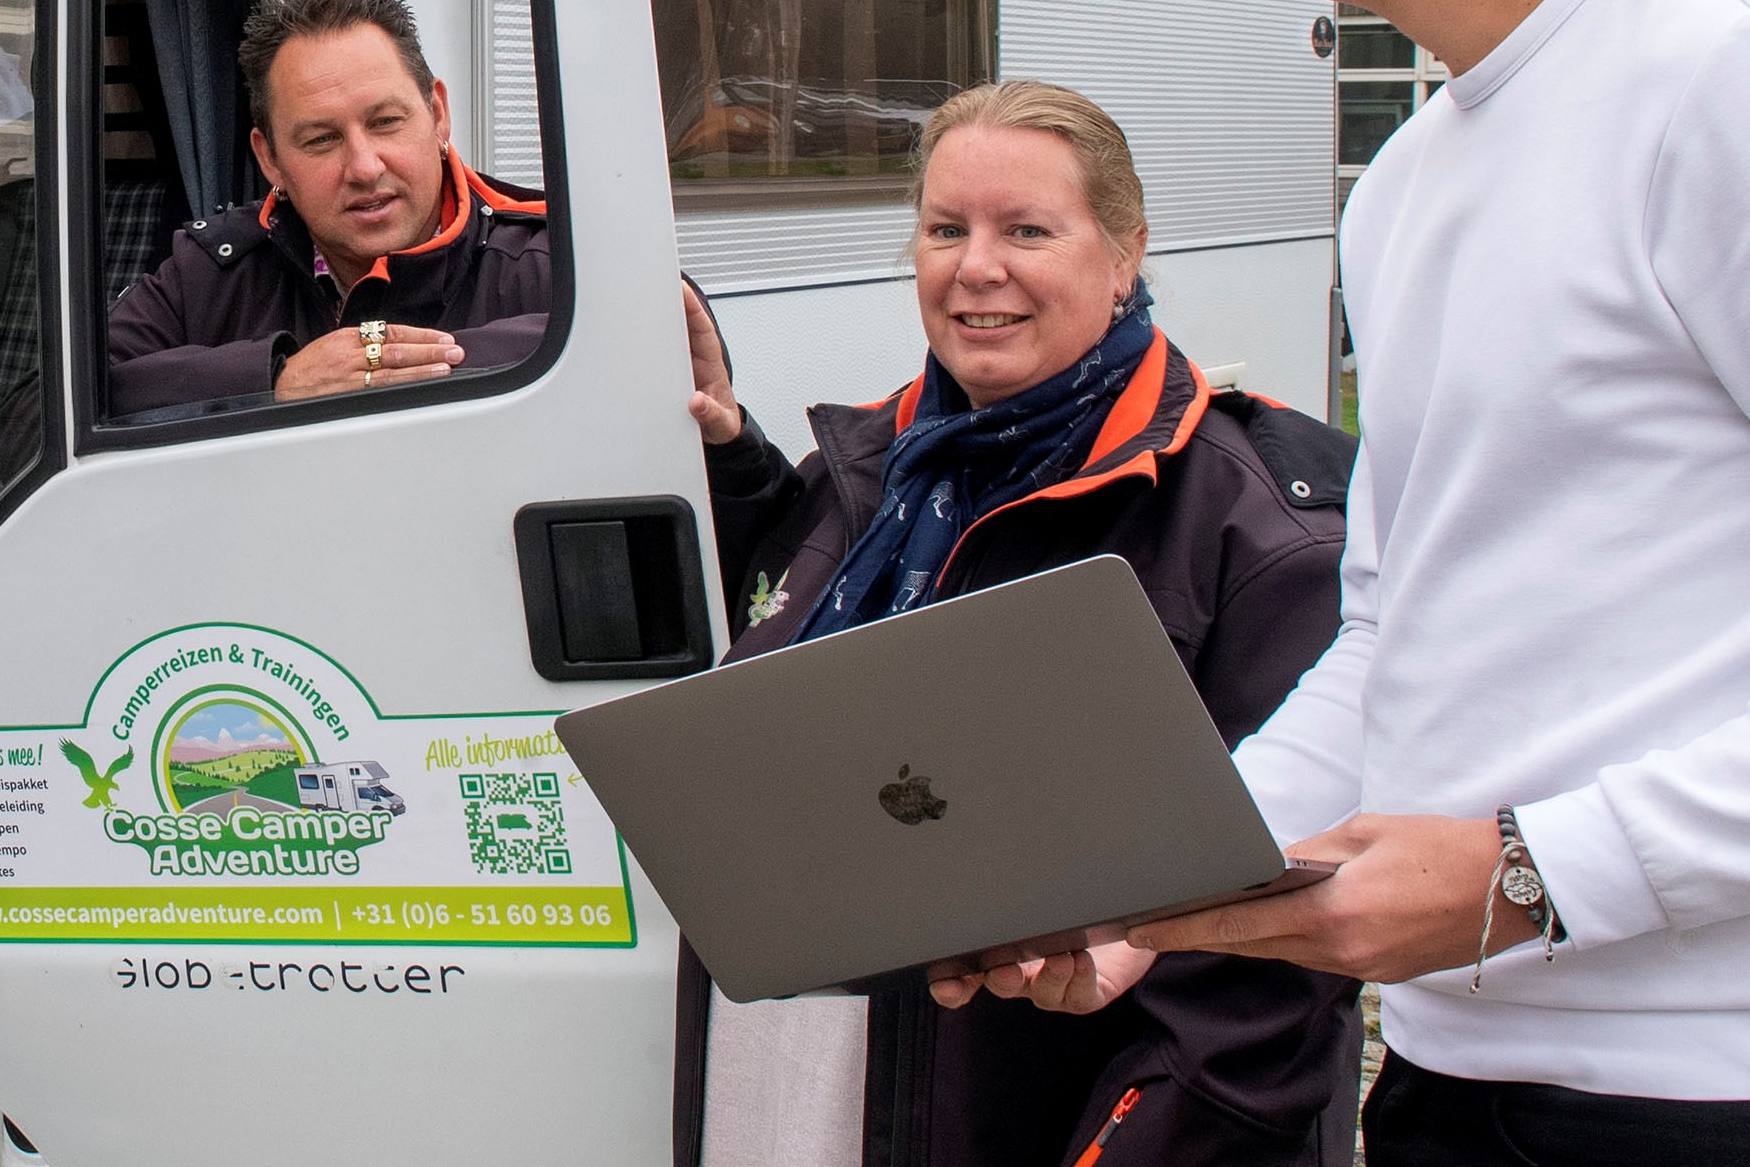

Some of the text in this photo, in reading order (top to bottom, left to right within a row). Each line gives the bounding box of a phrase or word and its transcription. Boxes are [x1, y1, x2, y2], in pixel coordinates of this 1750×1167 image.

[113, 644, 350, 742] Camperreizen & Trainingen
[8, 743, 43, 766] mee!
[426, 737, 462, 771] Alle
[105, 811, 390, 845] Cosse Camper
[152, 843, 359, 875] Adventure
[352, 903, 396, 925] +31
[401, 901, 450, 929] (0)6
[471, 903, 500, 926] 51
[507, 903, 537, 926] 60
[543, 904, 574, 926] 93
[580, 904, 611, 926] 06
